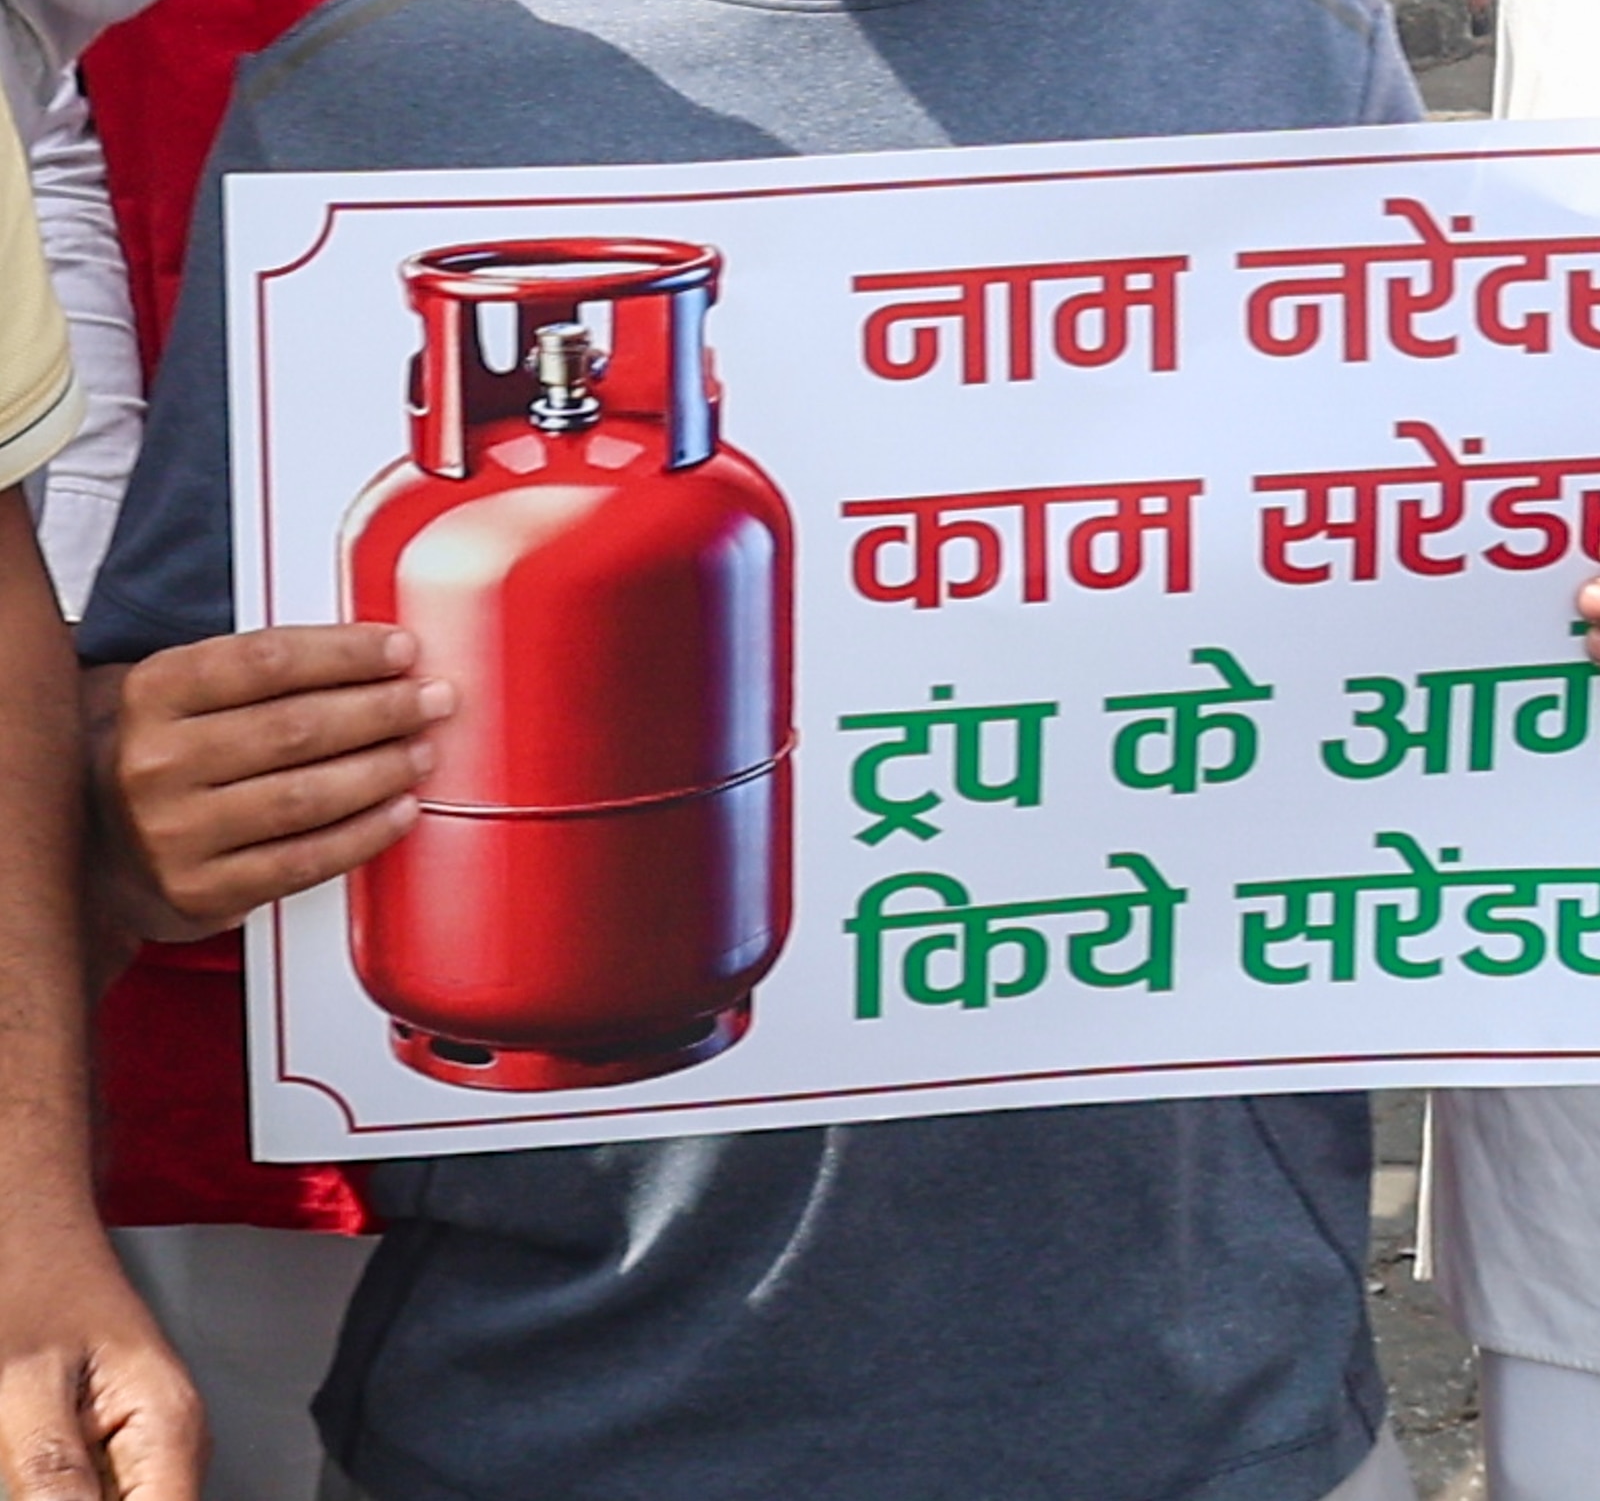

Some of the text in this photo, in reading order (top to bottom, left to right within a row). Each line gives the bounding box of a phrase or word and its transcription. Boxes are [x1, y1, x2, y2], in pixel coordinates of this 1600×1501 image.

[852, 254, 1190, 386] नाम
[841, 478, 1204, 611] काम
[838, 684, 1060, 848] ट्रंप
[1103, 646, 1275, 796] के
[842, 851, 1190, 1021] किये
